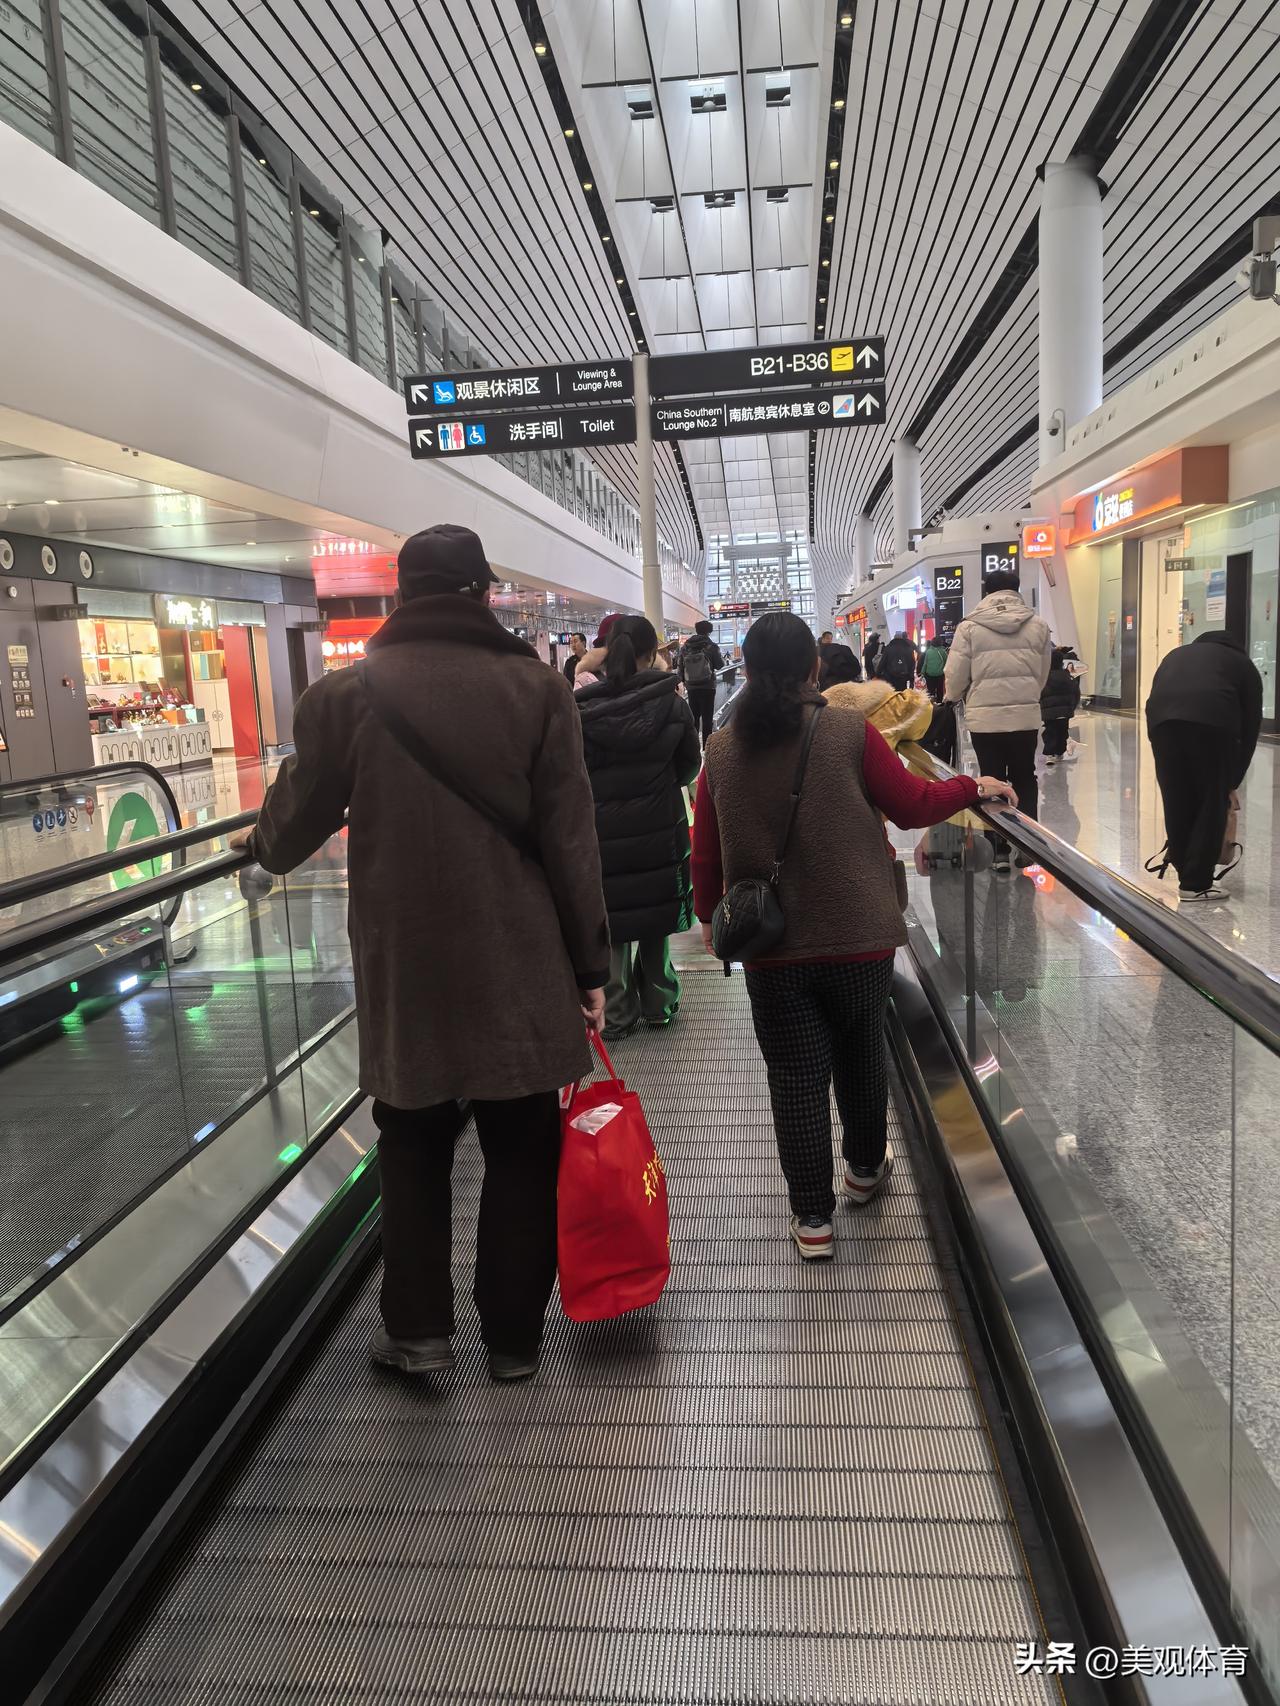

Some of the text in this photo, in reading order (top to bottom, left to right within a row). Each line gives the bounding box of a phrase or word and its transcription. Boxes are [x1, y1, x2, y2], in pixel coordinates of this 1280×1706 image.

[751, 352, 828, 376] B21-B36
[577, 367, 616, 380] Viewing &
[456, 377, 541, 400] 观景休闲区
[572, 379, 623, 391] Lounge Area
[656, 407, 722, 420] China Southern
[729, 402, 815, 422] 南航贵宾休息室
[509, 421, 558, 441] 洗手间
[580, 419, 615, 433] Toilet
[663, 418, 717, 431] Lounge No.2
[985, 554, 1016, 573] B21
[936, 577, 961, 591] B22
